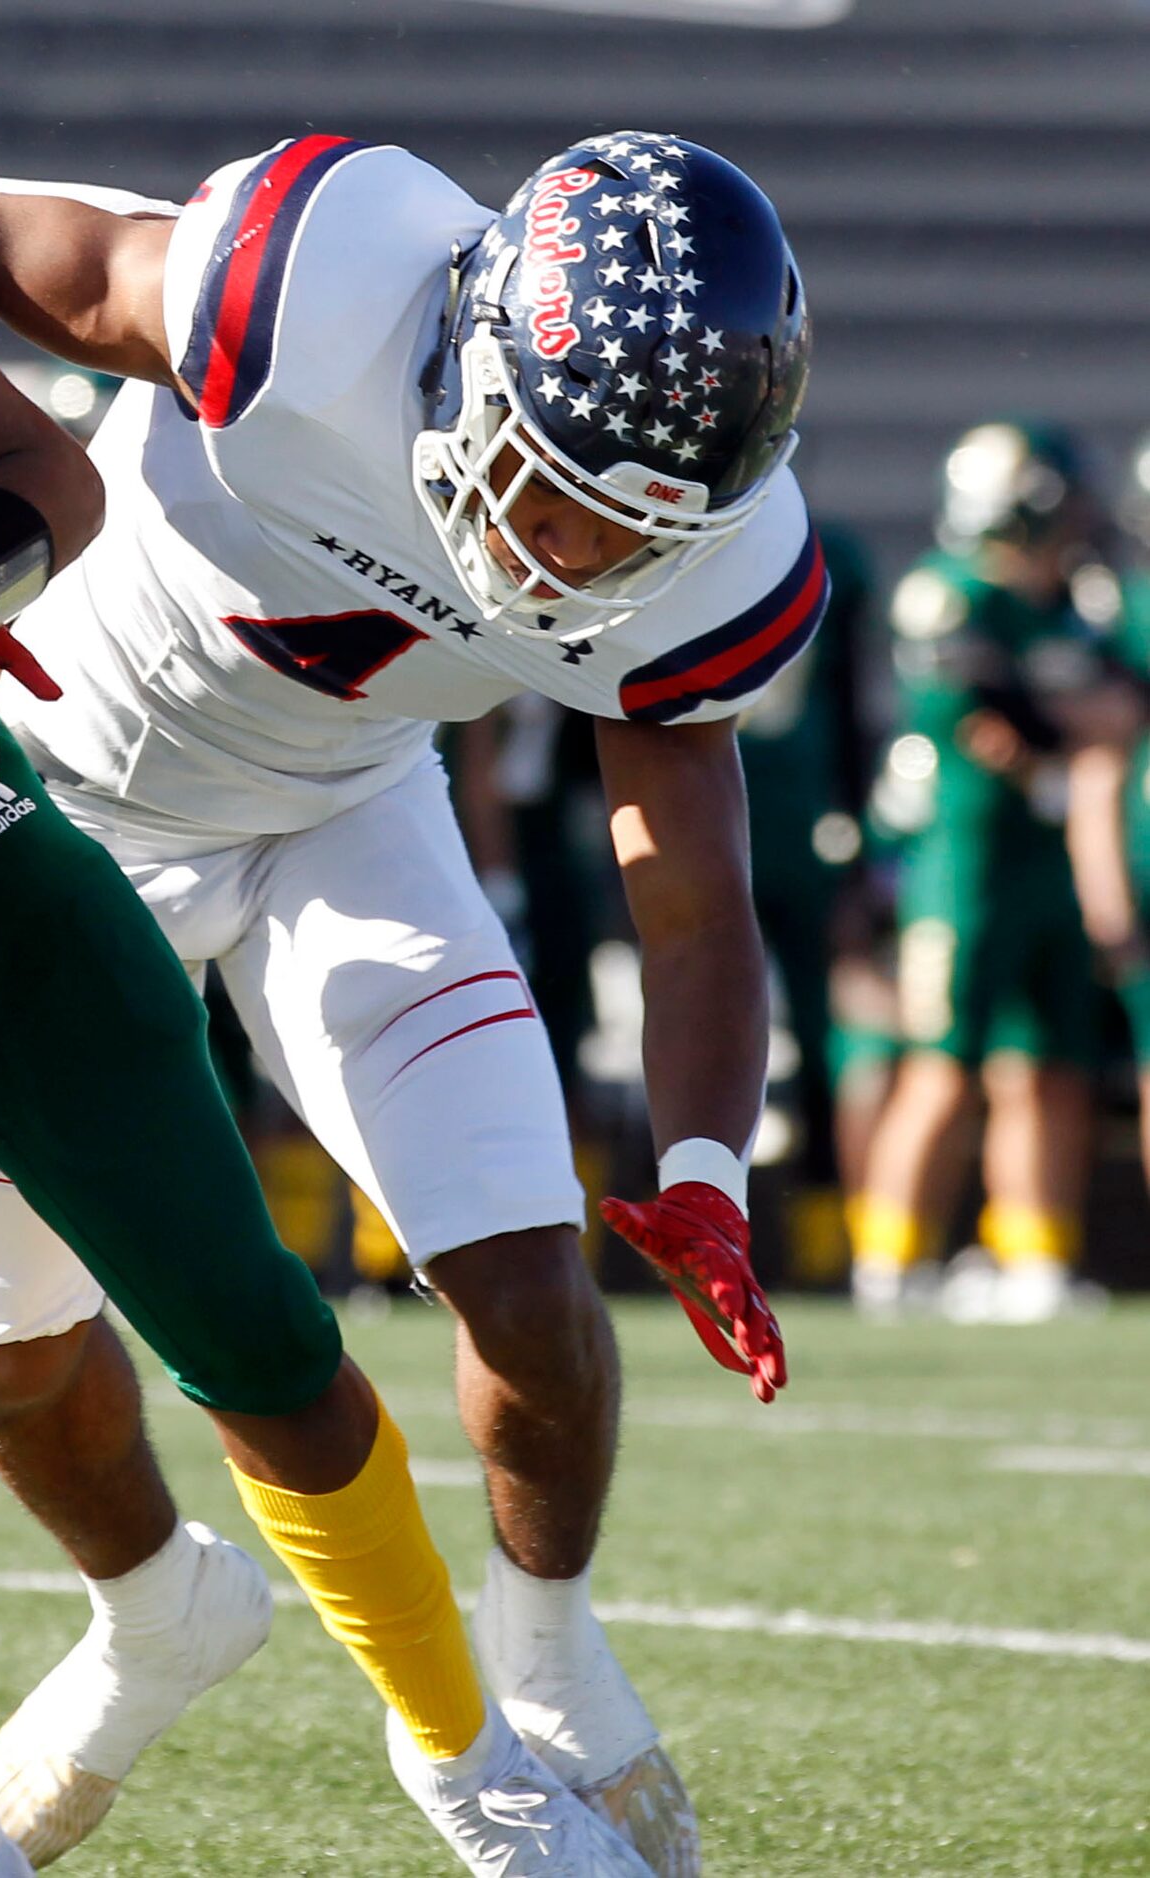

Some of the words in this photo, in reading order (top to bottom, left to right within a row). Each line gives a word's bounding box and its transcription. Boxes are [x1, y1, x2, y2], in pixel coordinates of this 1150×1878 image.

[522, 168, 599, 359] Raiders
[644, 481, 685, 504] ONE
[343, 549, 456, 622] RYAN
[219, 608, 433, 702] 4
